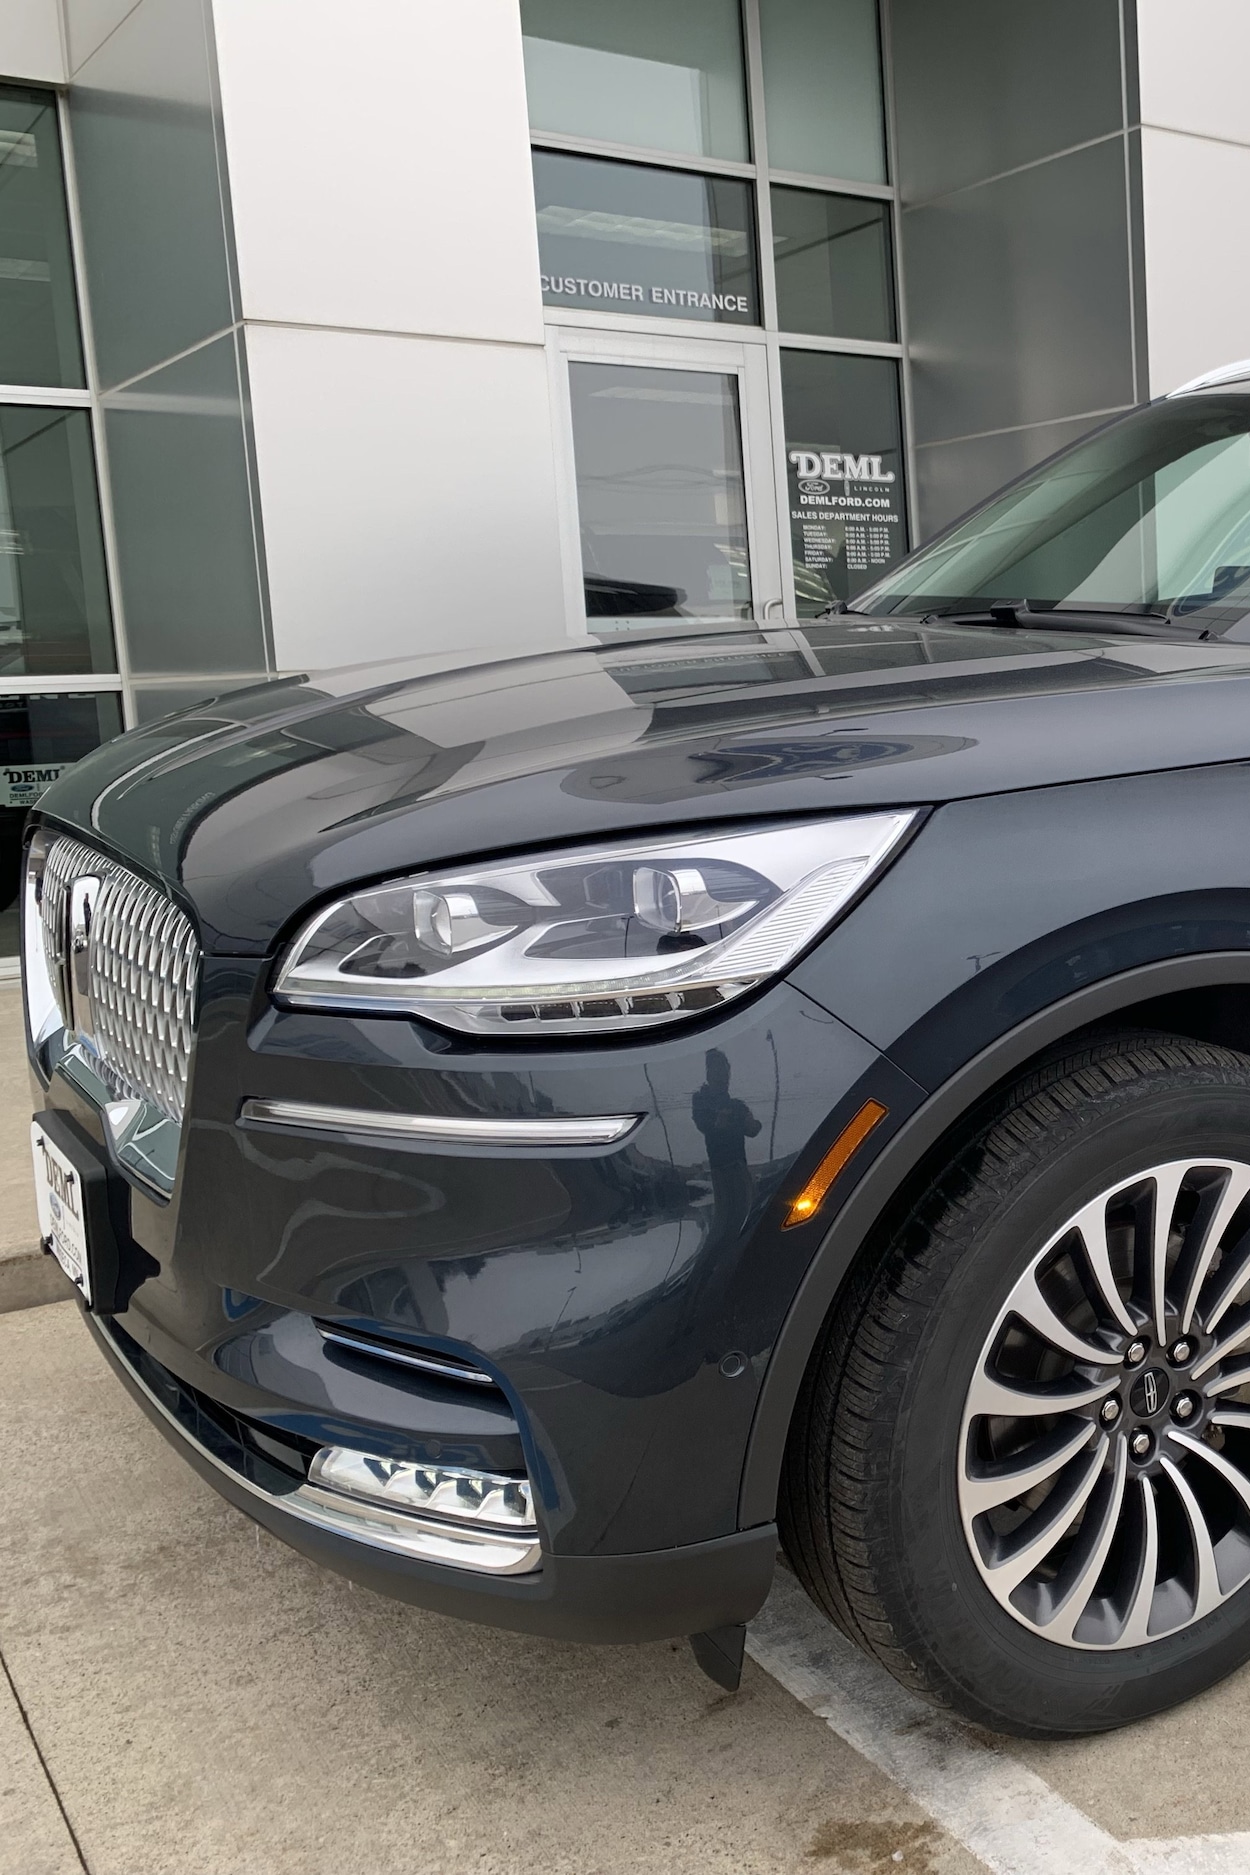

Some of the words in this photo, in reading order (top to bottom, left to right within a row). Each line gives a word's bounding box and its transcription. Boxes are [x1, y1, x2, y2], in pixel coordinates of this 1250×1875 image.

[540, 275, 644, 302] CUSTOMER
[652, 287, 749, 312] ENTRANCE
[789, 450, 895, 483] DEML
[854, 485, 890, 493] LINCOLN
[799, 495, 890, 508] DEMLFORD.COM
[791, 511, 818, 520] SALES
[818, 512, 871, 522] DEPARTMENT
[871, 514, 899, 523] HOURS
[42, 1146, 79, 1221] DEML
